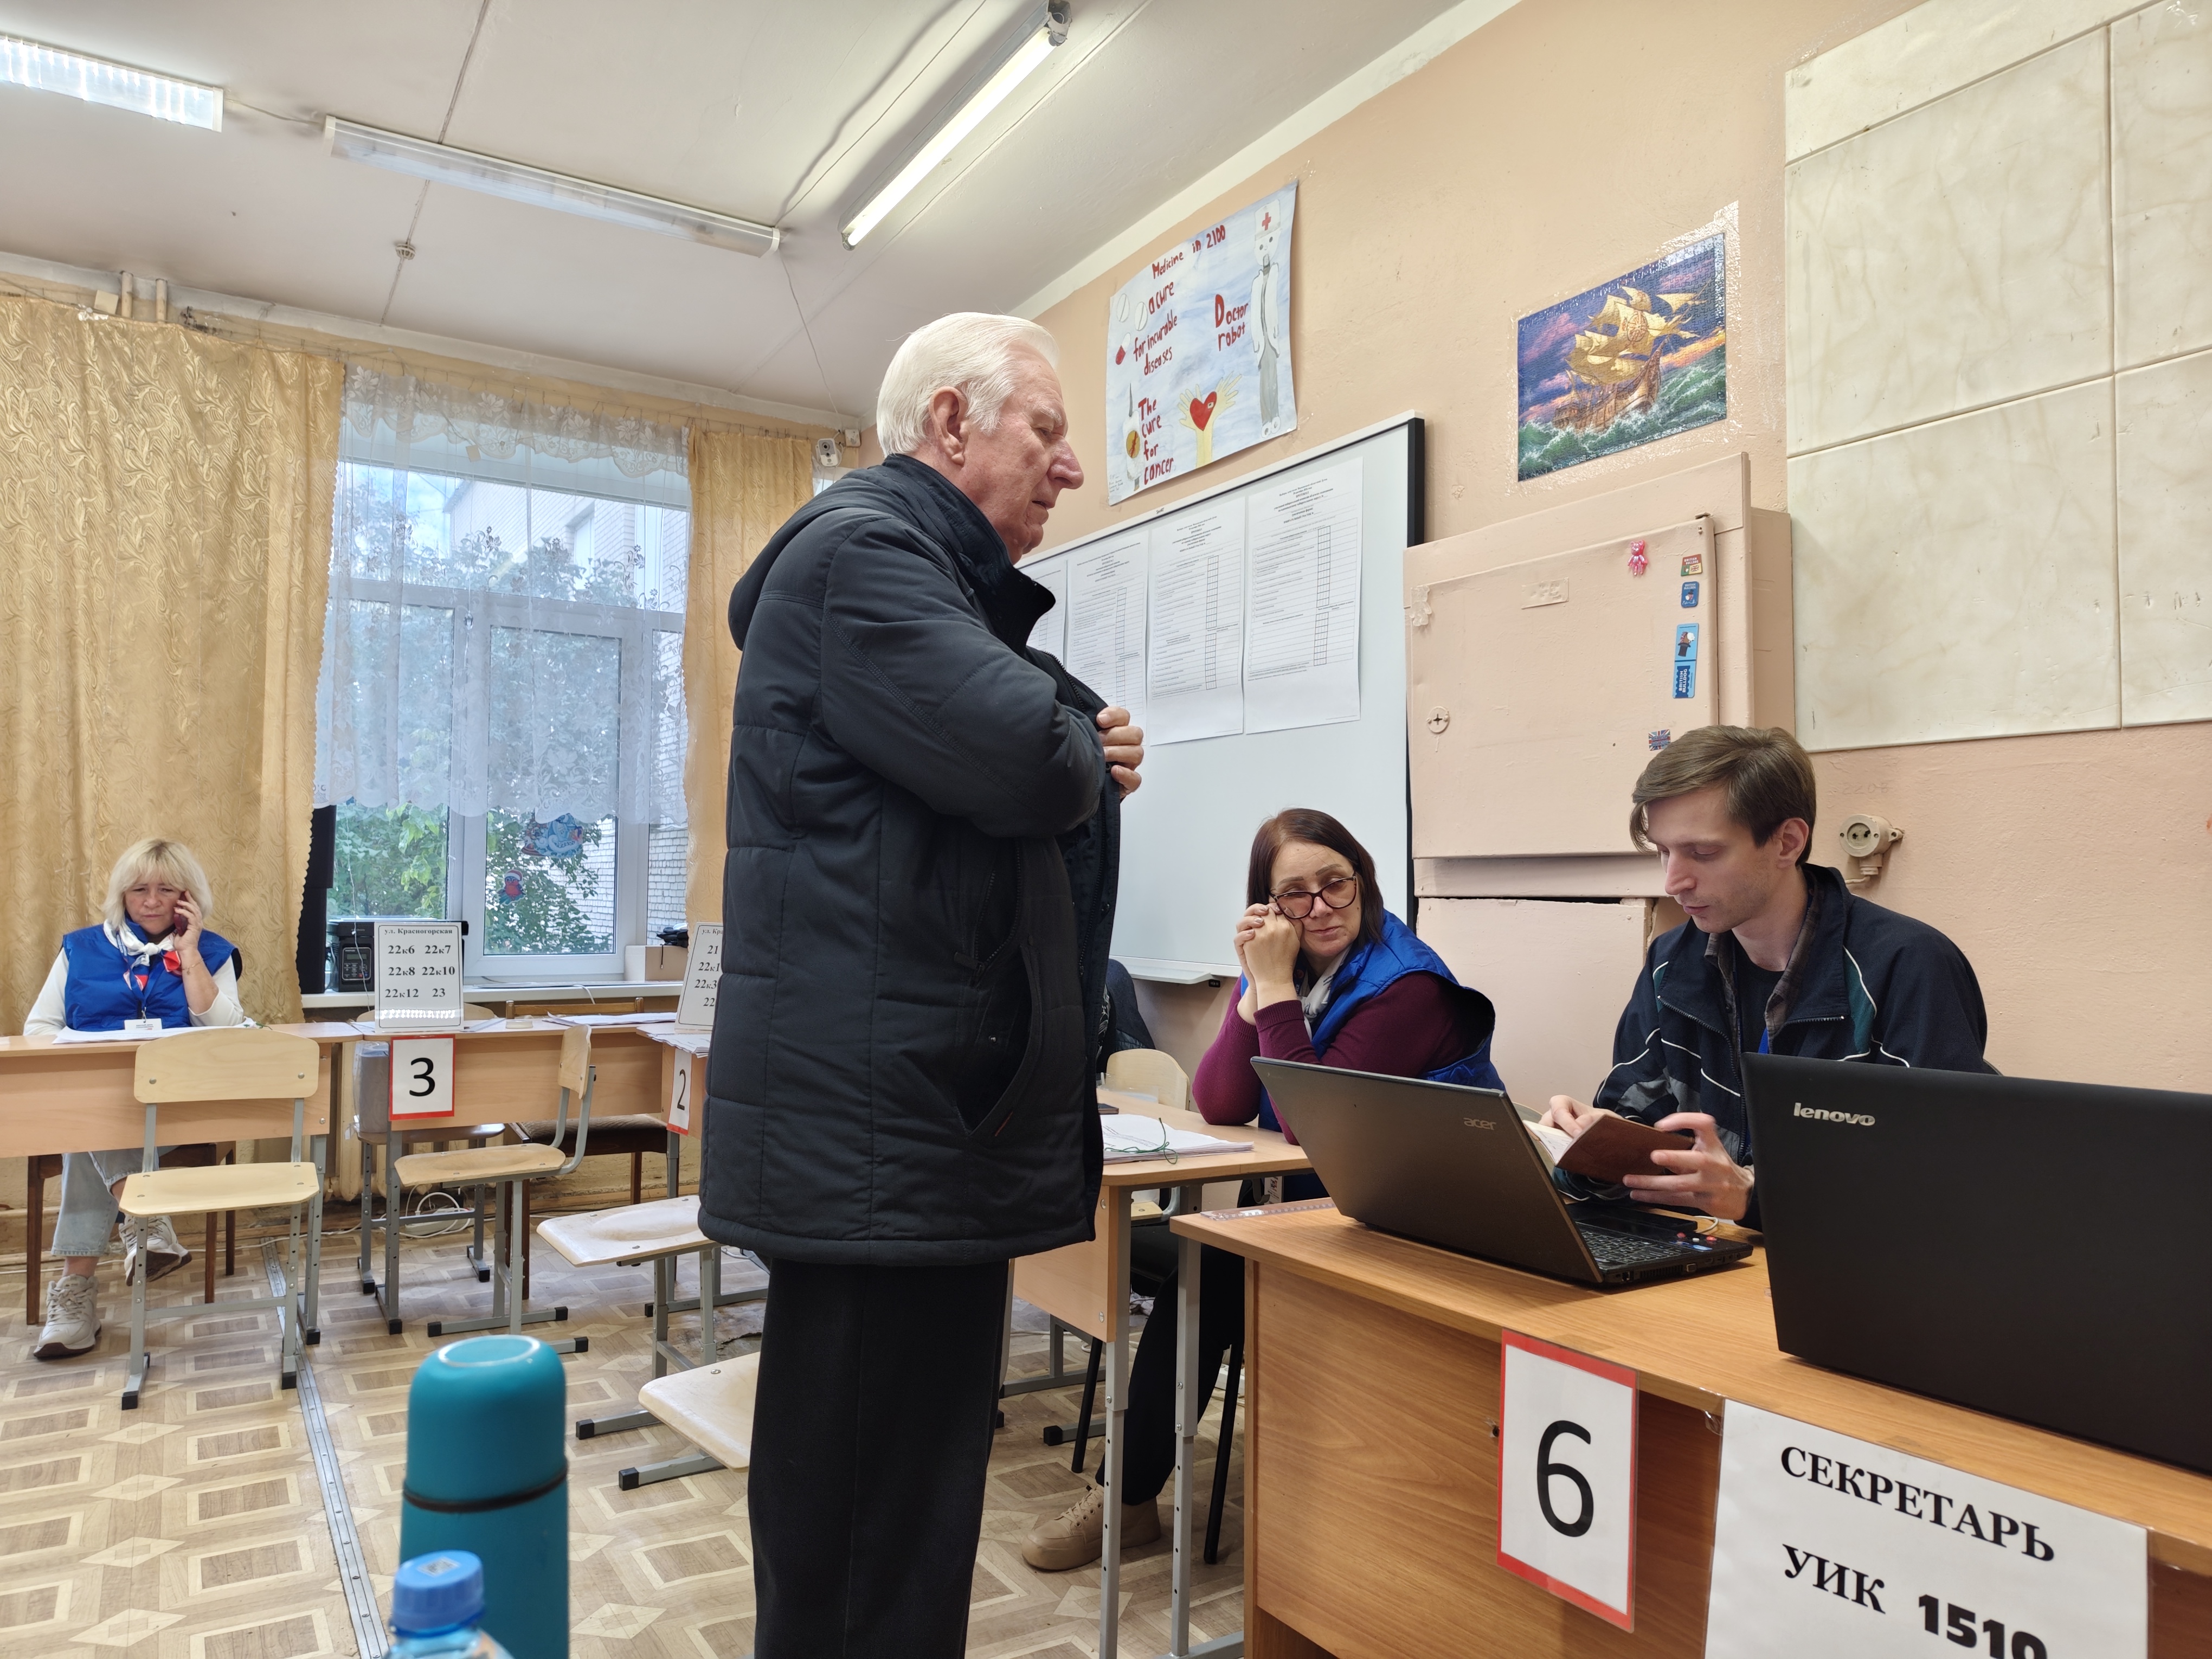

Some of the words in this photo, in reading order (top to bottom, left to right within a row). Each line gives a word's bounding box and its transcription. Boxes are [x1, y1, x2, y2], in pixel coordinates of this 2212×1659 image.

[1152, 252, 1184, 279] Medicine
[1192, 240, 1201, 253] in
[1206, 224, 1225, 249] 2100
[1215, 294, 1249, 328] Doctor
[1133, 337, 1146, 362] for
[1147, 309, 1177, 350] incurable
[1218, 321, 1245, 351] robot
[1144, 346, 1172, 376] diseases
[1138, 397, 1156, 421] The
[1142, 415, 1162, 438] cure
[1144, 440, 1159, 461] for
[388, 945, 415, 954] 22к6
[425, 945, 451, 954] 22к7
[707, 945, 718, 954] 21
[388, 967, 415, 976] 22к8
[422, 966, 455, 975] 22к10
[698, 962, 720, 972] 22к1
[385, 988, 419, 998] 22к12
[432, 988, 446, 997] 23
[695, 979, 717, 989] 22к3
[703, 998, 715, 1007] 22
[409, 1057, 435, 1097] 3
[677, 1069, 686, 1110] 2
[1463, 1117, 1497, 1130] acer
[1793, 1102, 1875, 1126] lenovo
[1537, 1420, 1594, 1537] 6
[1780, 1446, 2055, 1561] СЕКРЕТАРЬ
[1782, 1544, 1886, 1614] УИК
